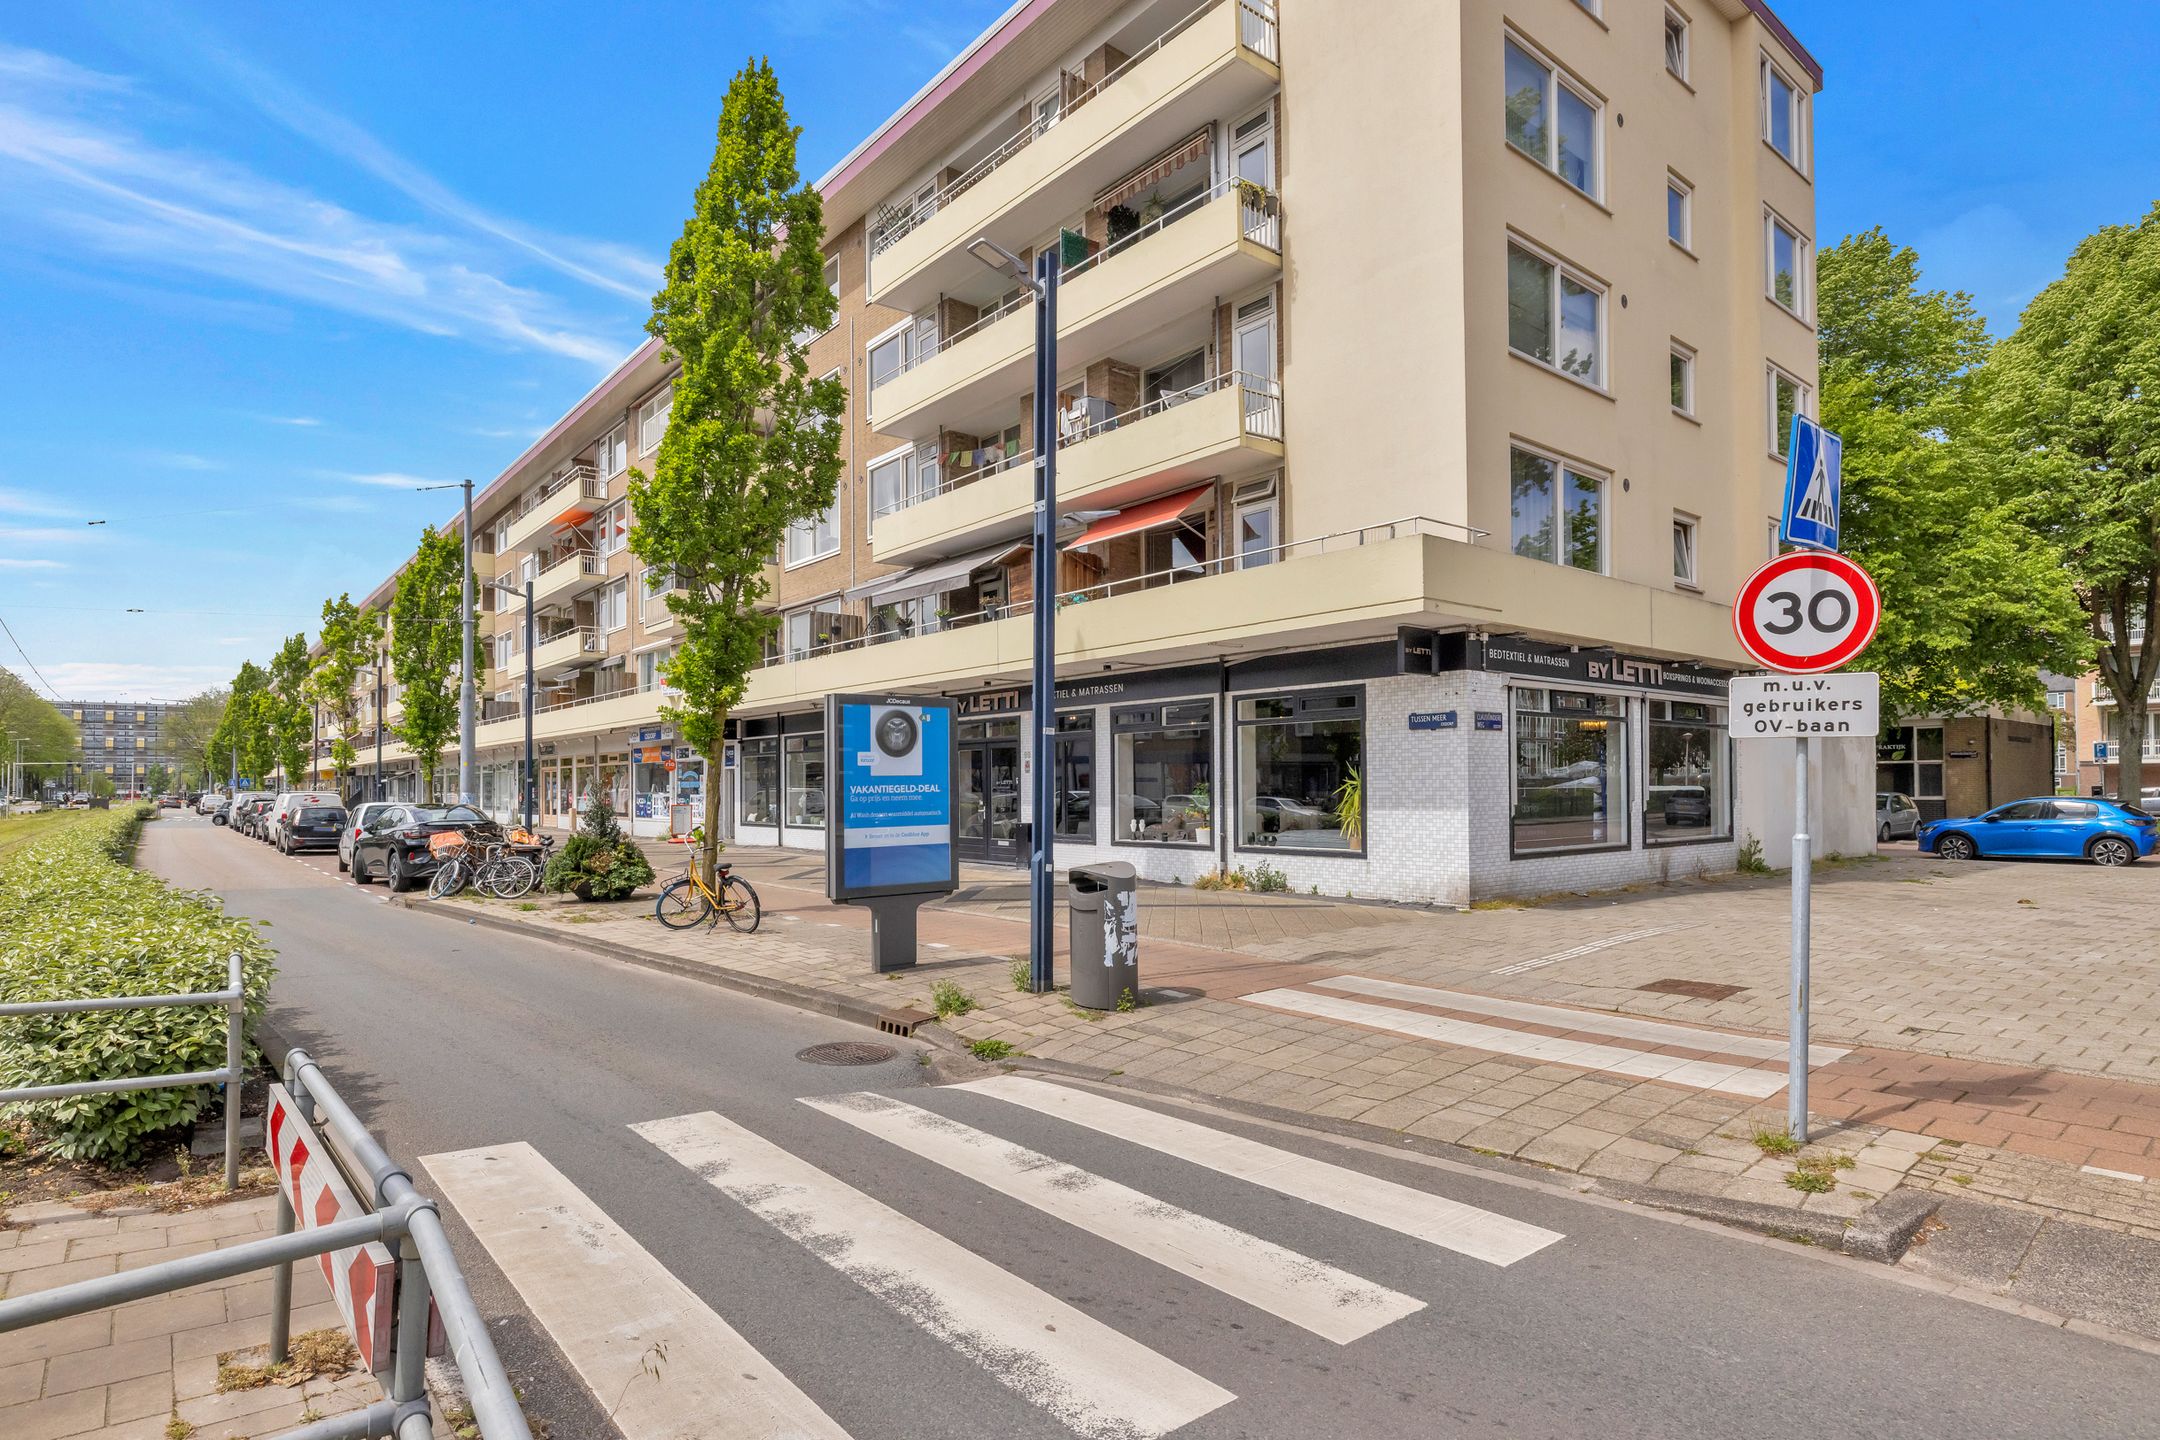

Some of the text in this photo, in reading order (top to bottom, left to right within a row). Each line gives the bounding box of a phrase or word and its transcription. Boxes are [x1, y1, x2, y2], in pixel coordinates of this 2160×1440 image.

[1762, 588, 1852, 635] 30
[1489, 648, 1570, 668] BEDTEXTIEL & MATRASSEN
[1588, 657, 1663, 686] BY LETTI
[1663, 672, 1692, 684] BOXSPRINGS
[1078, 683, 1124, 697] MATRASSEN
[1764, 679, 1831, 692] m.u.v.
[958, 691, 1018, 713] Y LETTI
[1743, 698, 1863, 717] gebruikers
[1411, 714, 1447, 723] TUSSEN MEER
[1754, 719, 1850, 733] OV-baan
[849, 784, 941, 794] VAKANTIEGELD-DEAL
